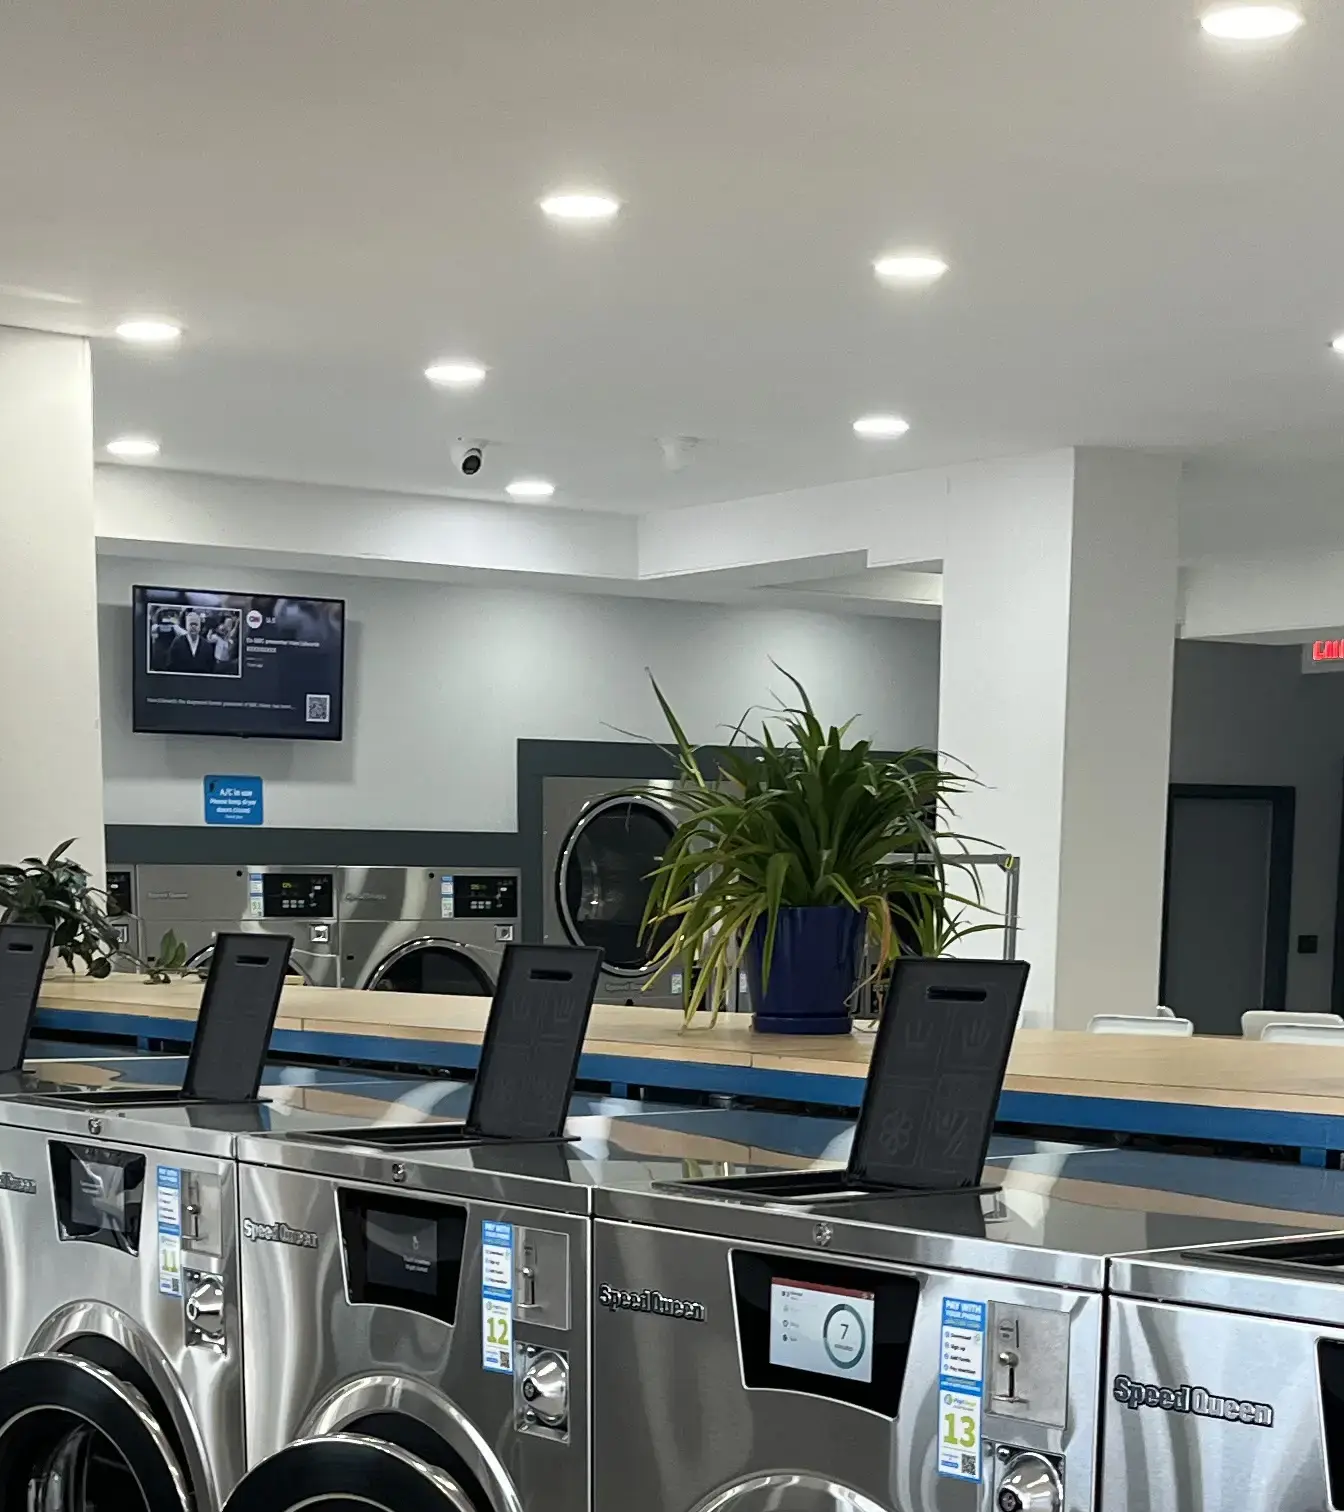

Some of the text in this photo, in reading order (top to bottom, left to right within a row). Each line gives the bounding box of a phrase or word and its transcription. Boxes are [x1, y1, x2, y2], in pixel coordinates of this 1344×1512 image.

[243, 1217, 278, 1243] Speed
[162, 1248, 178, 1273] 11
[599, 1282, 706, 1322] Speed Queen
[486, 1317, 509, 1346] 12
[839, 1323, 850, 1340] 7
[1114, 1374, 1274, 1428] Speed Queen
[943, 1412, 976, 1448] 13
